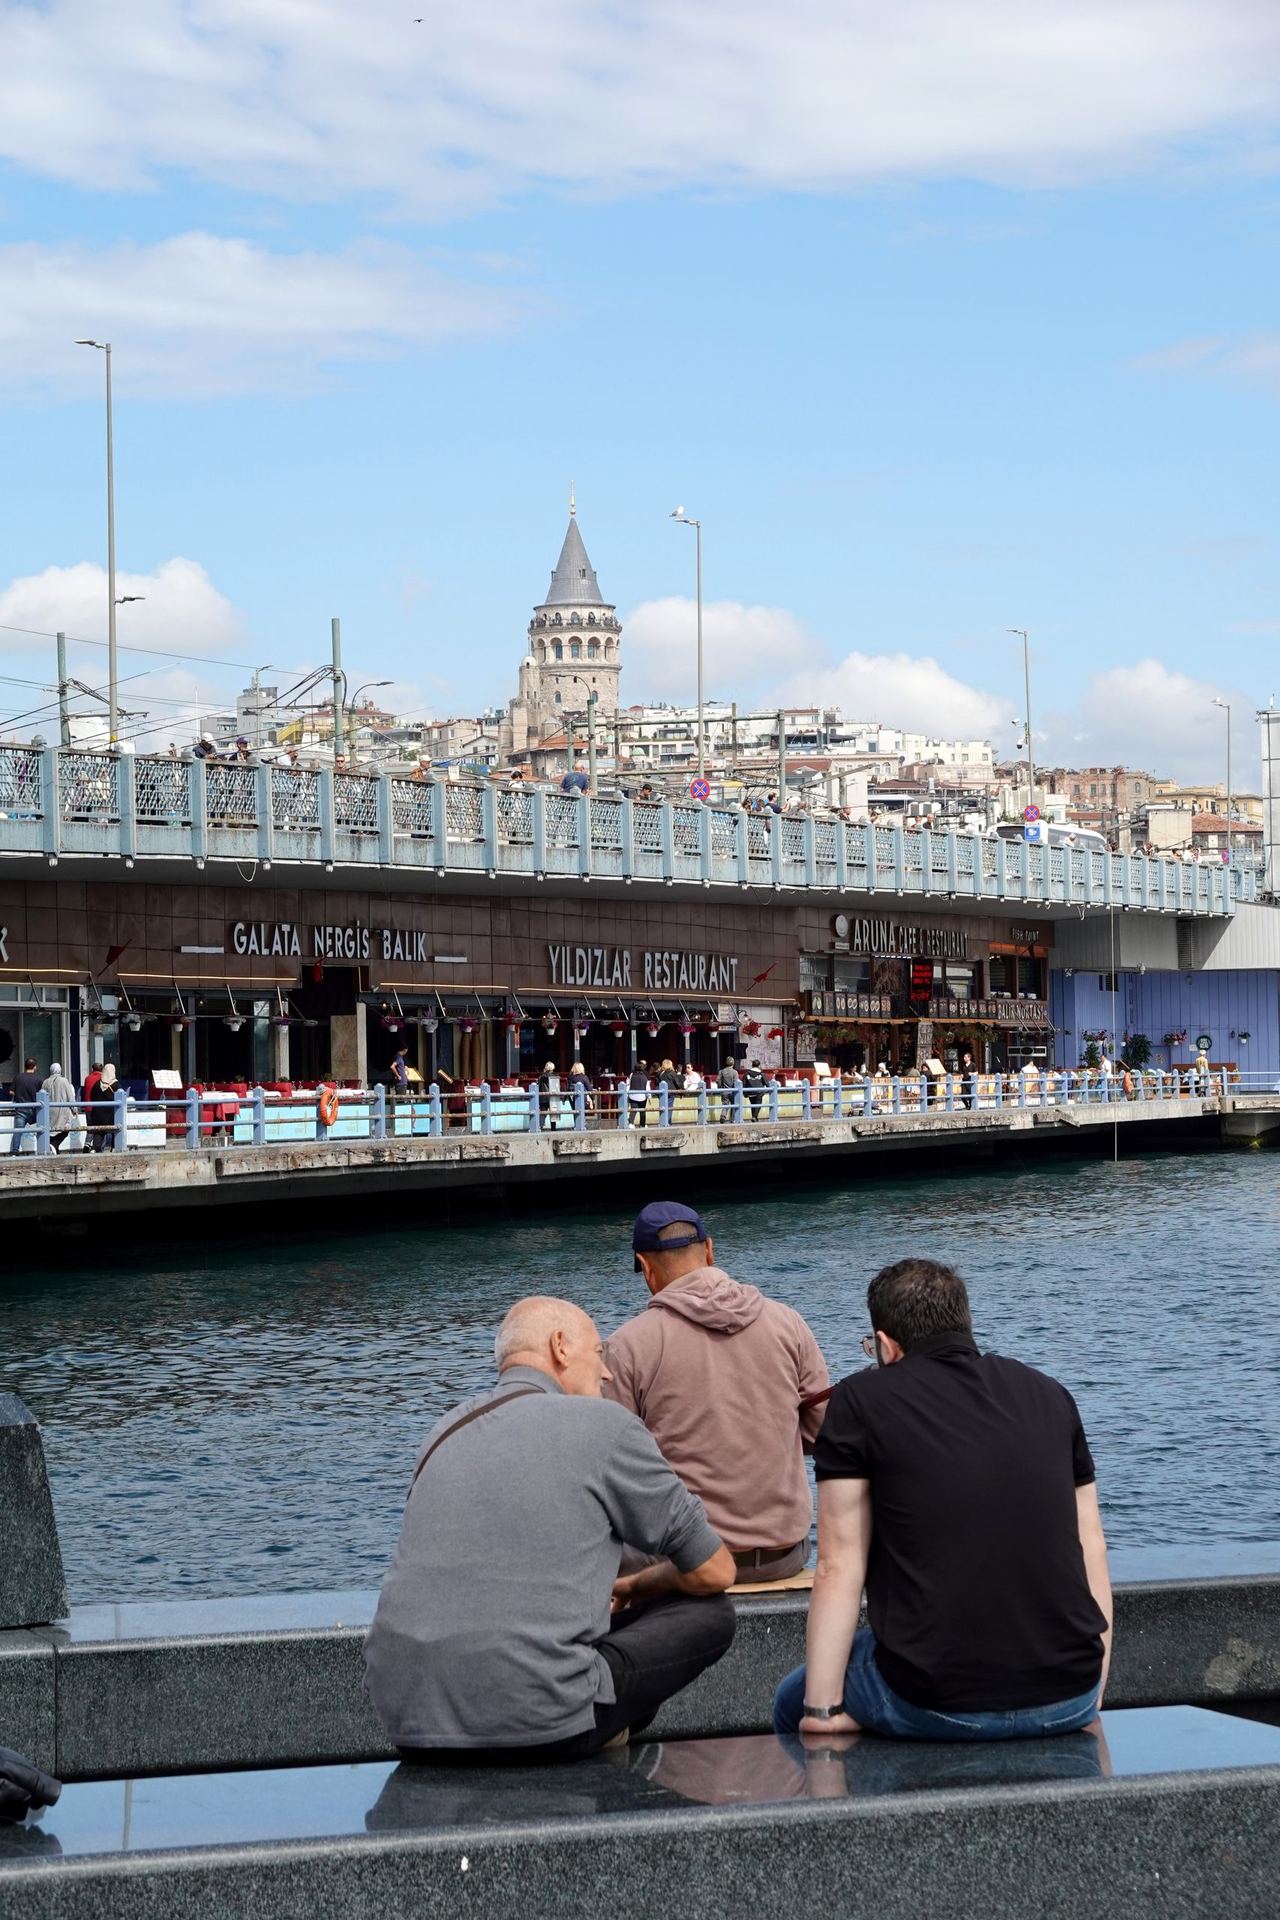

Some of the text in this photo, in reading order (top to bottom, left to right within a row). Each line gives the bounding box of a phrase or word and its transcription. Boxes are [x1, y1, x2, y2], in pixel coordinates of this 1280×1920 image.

[233, 920, 427, 962] GALATA NERGİS BALIK
[853, 919, 896, 953] ARUNA
[899, 926, 917, 954] CAFE
[927, 929, 968, 958] RESTAURANT
[549, 945, 738, 992] YILDIZLAR RESTAURANT
